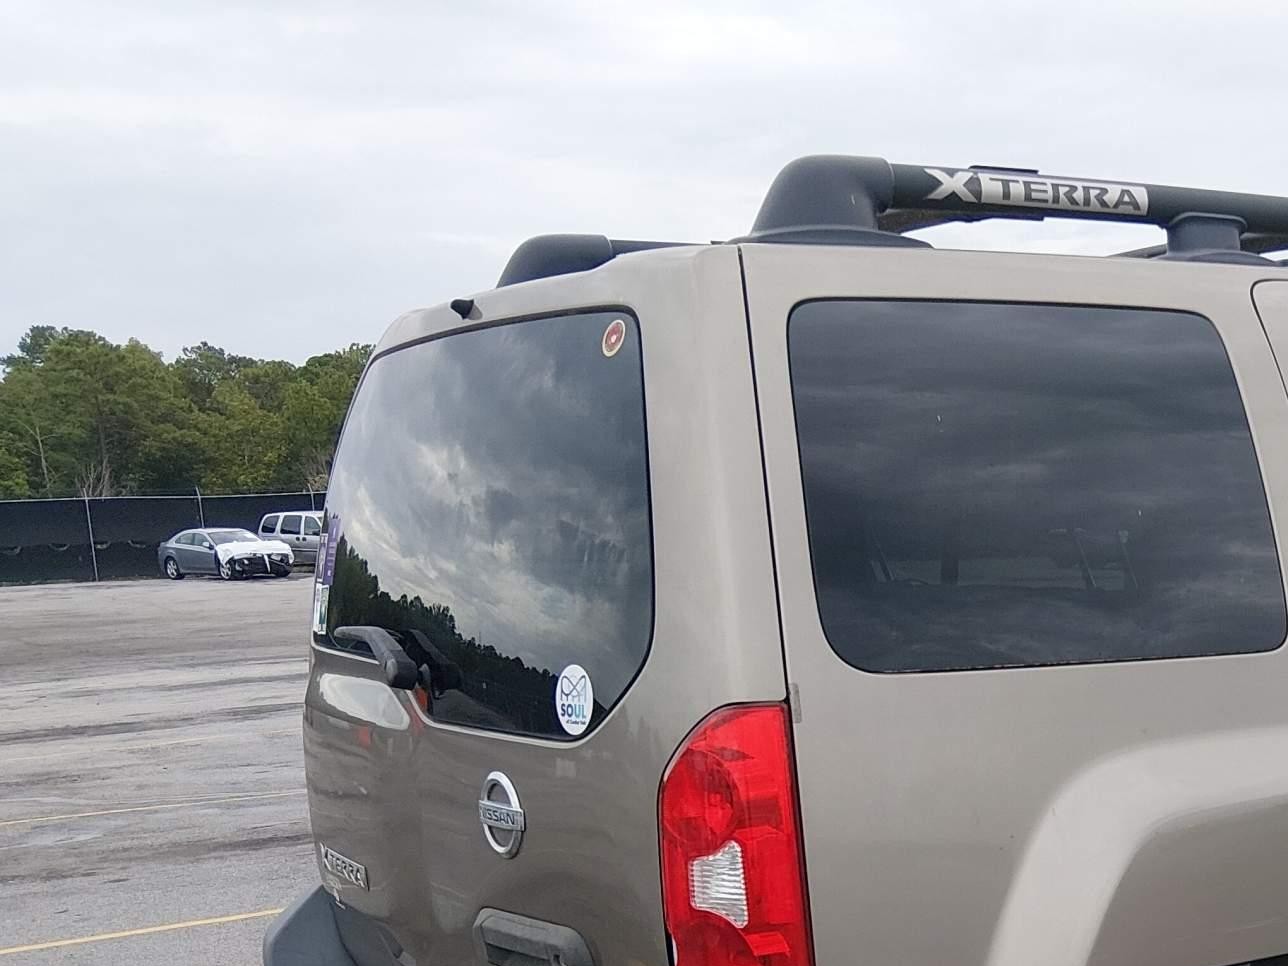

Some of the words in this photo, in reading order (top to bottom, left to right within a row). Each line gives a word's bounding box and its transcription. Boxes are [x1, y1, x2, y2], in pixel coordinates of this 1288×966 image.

[924, 168, 1143, 212] XTERRA
[560, 702, 587, 719] SOUL
[480, 806, 516, 826] NISSAN
[319, 842, 368, 890] XTERRA
